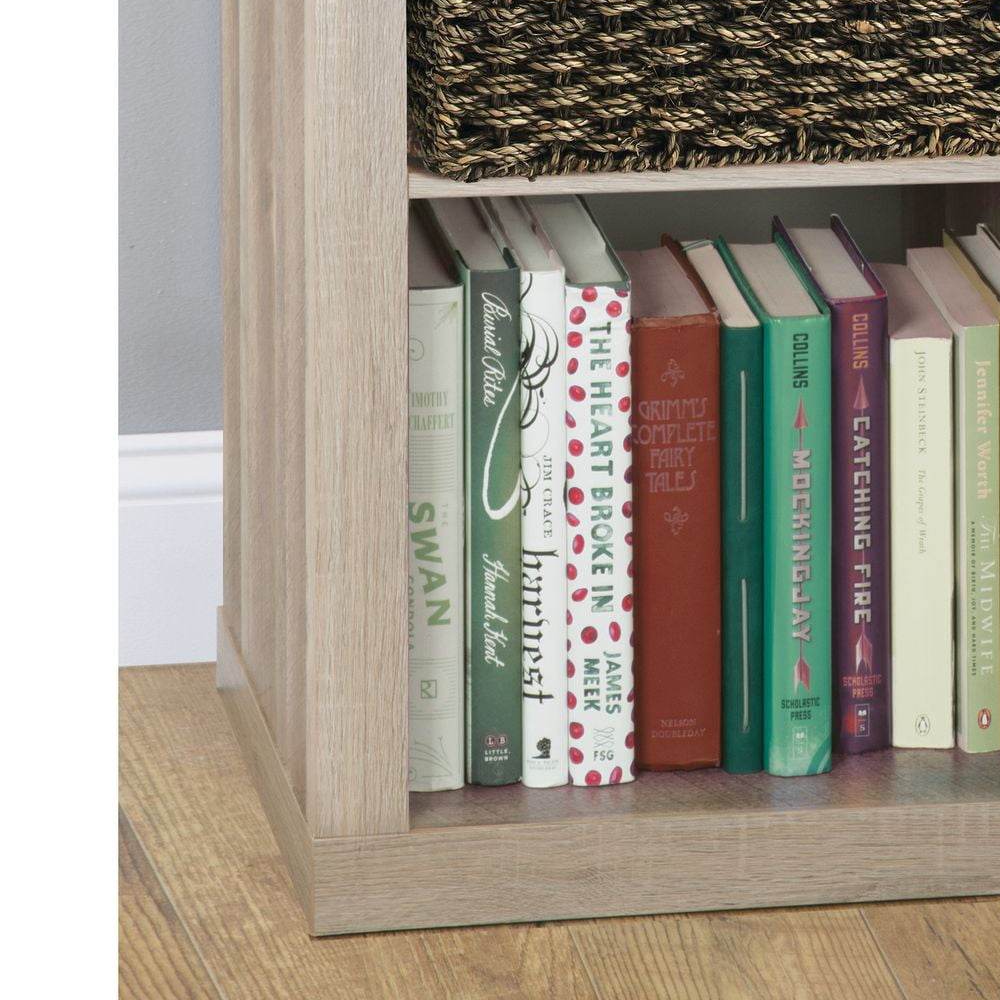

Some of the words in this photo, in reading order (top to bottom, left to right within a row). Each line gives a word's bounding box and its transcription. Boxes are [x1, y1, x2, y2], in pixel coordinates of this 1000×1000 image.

[481, 291, 512, 356] Burial
[589, 321, 612, 371] THE
[852, 313, 869, 369] COLLINS
[481, 355, 506, 408] Rites
[792, 333, 809, 389] COLLINS
[915, 351, 926, 382] JOHN
[409, 391, 448, 408] IMOTHY
[638, 397, 709, 421] GRIMM'S
[917, 388, 928, 454] STEINBECK
[975, 360, 993, 434] Jennifer
[590, 381, 613, 476] HEART
[543, 455, 552, 481] JIM
[645, 470, 697, 493] TALES
[650, 446, 697, 469] FAIRY
[853, 416, 872, 551] CATCHING
[976, 440, 993, 500] Worth
[543, 488, 553, 539] CRACE
[590, 487, 614, 575] BROKE
[408, 502, 451, 626] SWAN
[791, 449, 812, 642] MOCKINGJAY
[482, 553, 510, 624] Hannah
[591, 585, 614, 613] IN
[853, 563, 872, 624] FIRE
[483, 622, 509, 667] Kent
[979, 560, 996, 677] MIDWIFE
[584, 658, 600, 711] MEEK
[603, 651, 622, 715] JAMES
[781, 696, 821, 710] SCHOLASTIC
[843, 674, 882, 687] SCHOLASTIC
[852, 687, 874, 698] PRESS
[651, 728, 707, 739] DOUBLEDAY
[790, 709, 812, 721] PRESS
[593, 750, 615, 761] FSG
